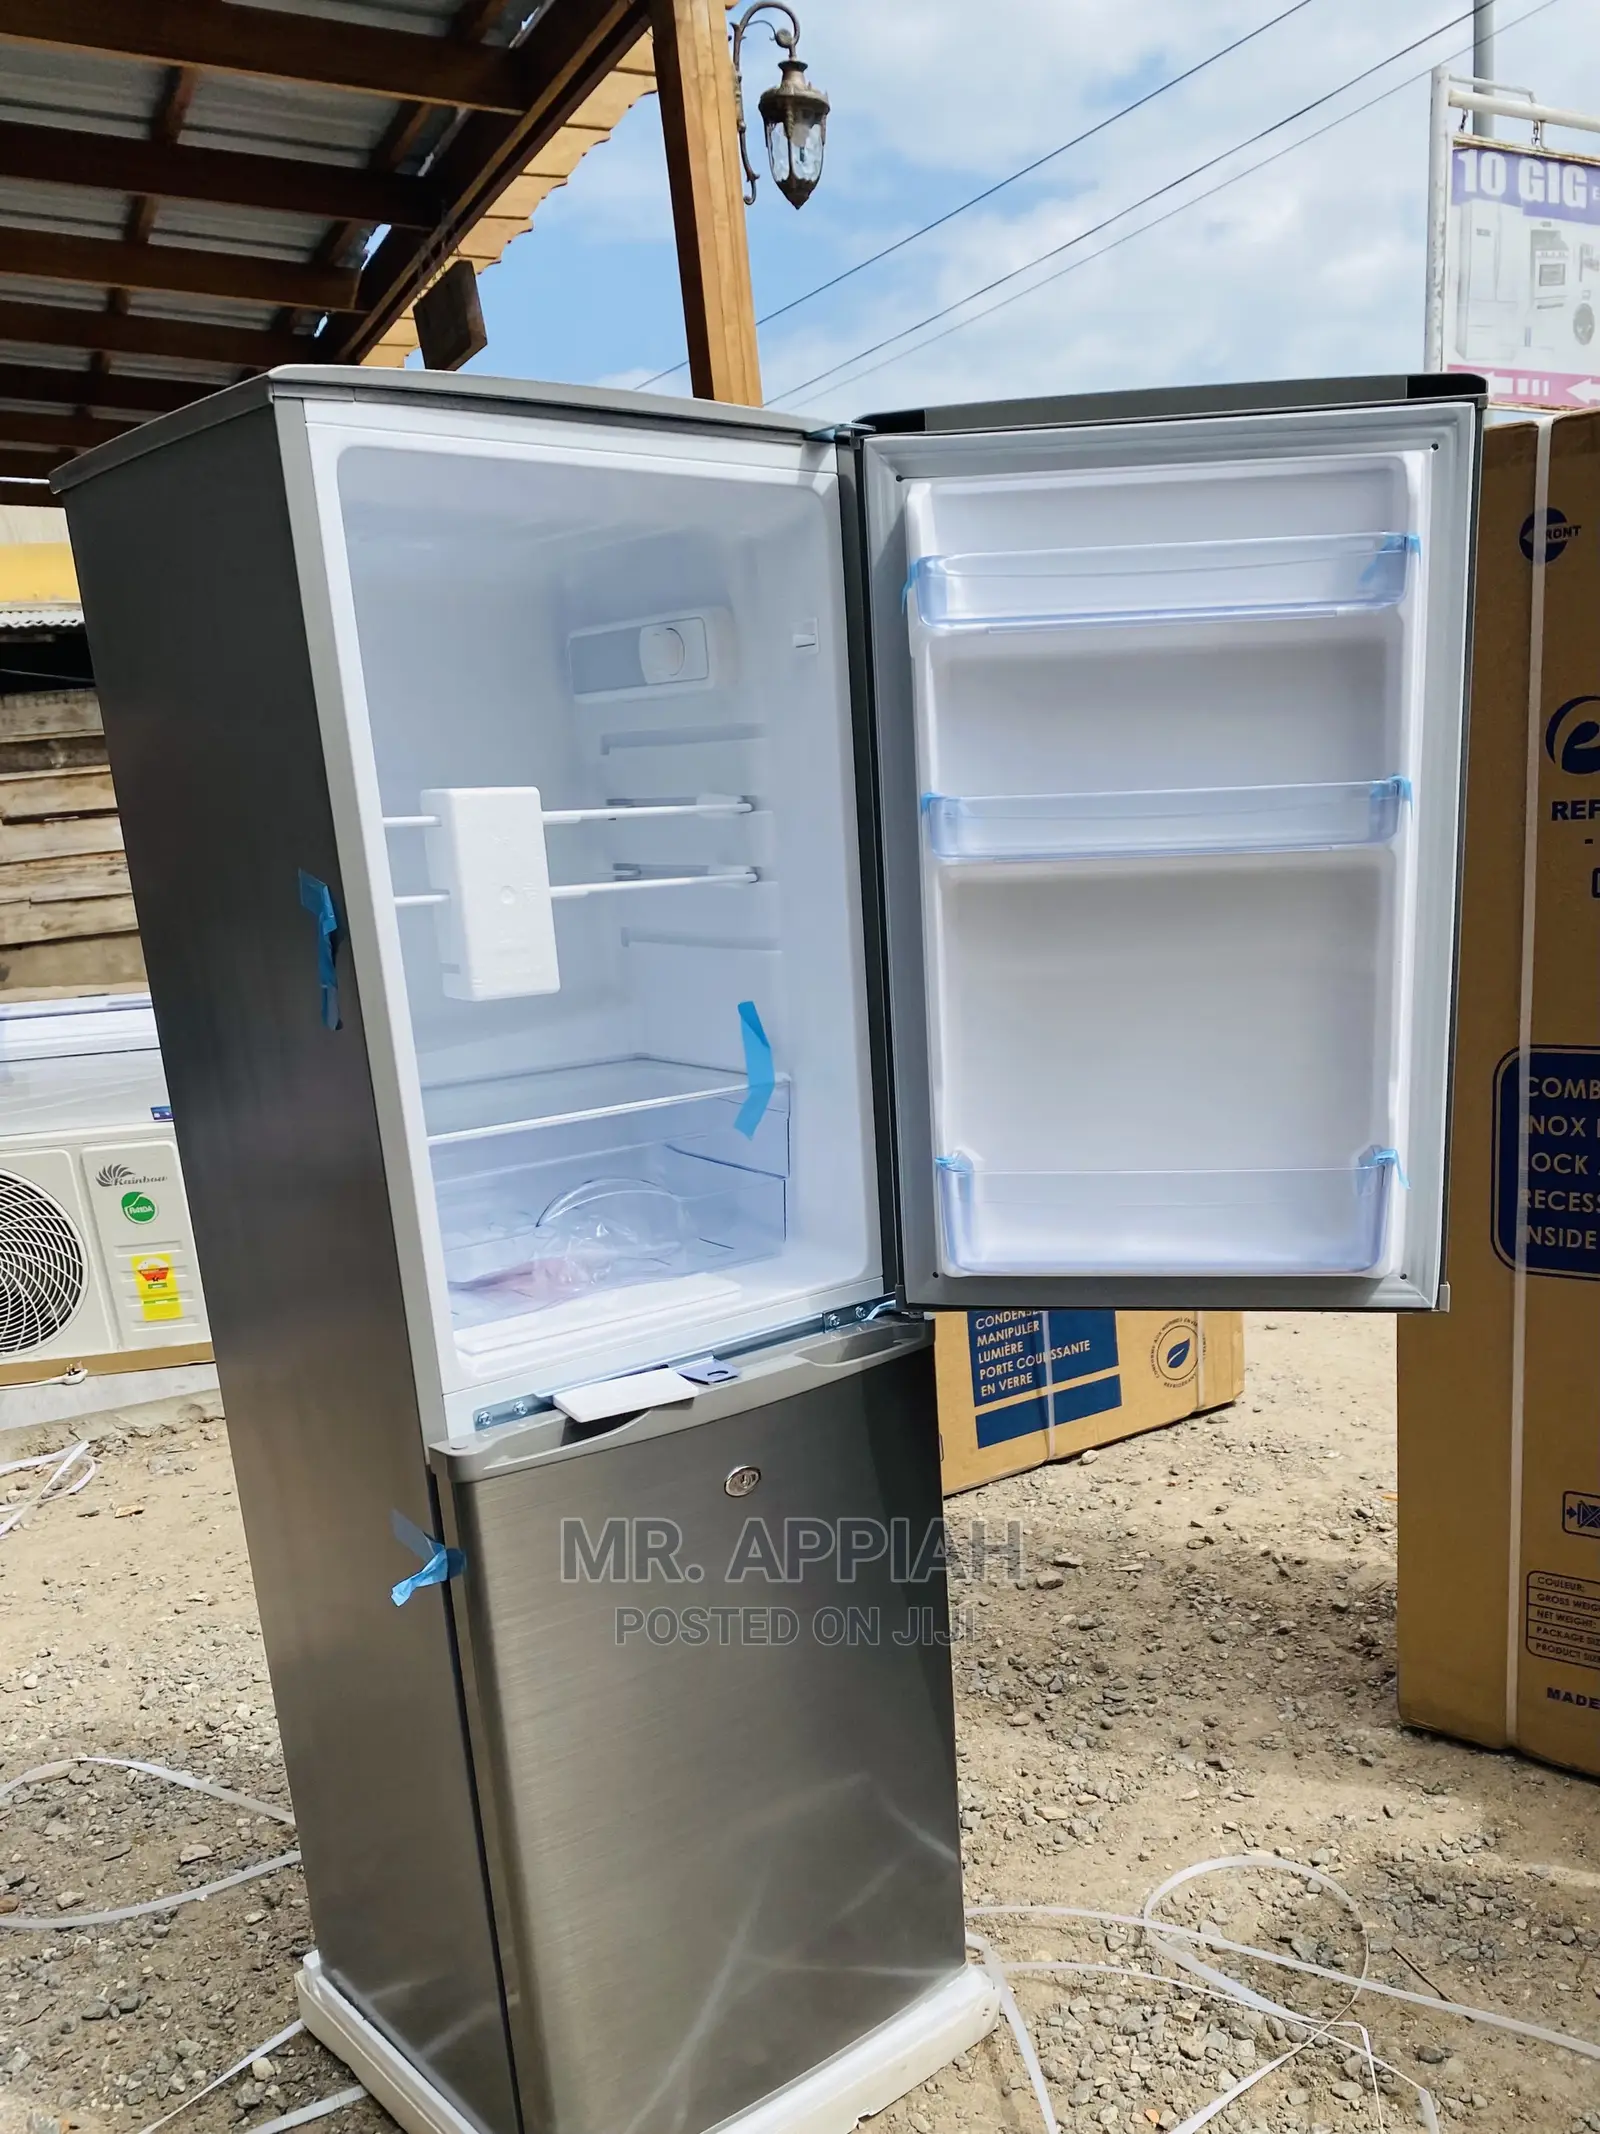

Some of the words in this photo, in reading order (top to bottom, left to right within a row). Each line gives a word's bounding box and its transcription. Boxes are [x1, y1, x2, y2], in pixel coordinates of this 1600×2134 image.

[1458, 149, 1506, 196] 10
[1518, 157, 1587, 209] GIG
[976, 1320, 1040, 1347] MANIPULER
[978, 1340, 1024, 1364] LUMIÈRE
[980, 1360, 1014, 1380] PORTE
[981, 1384, 996, 1397] EN
[998, 1372, 1033, 1391] VERRE
